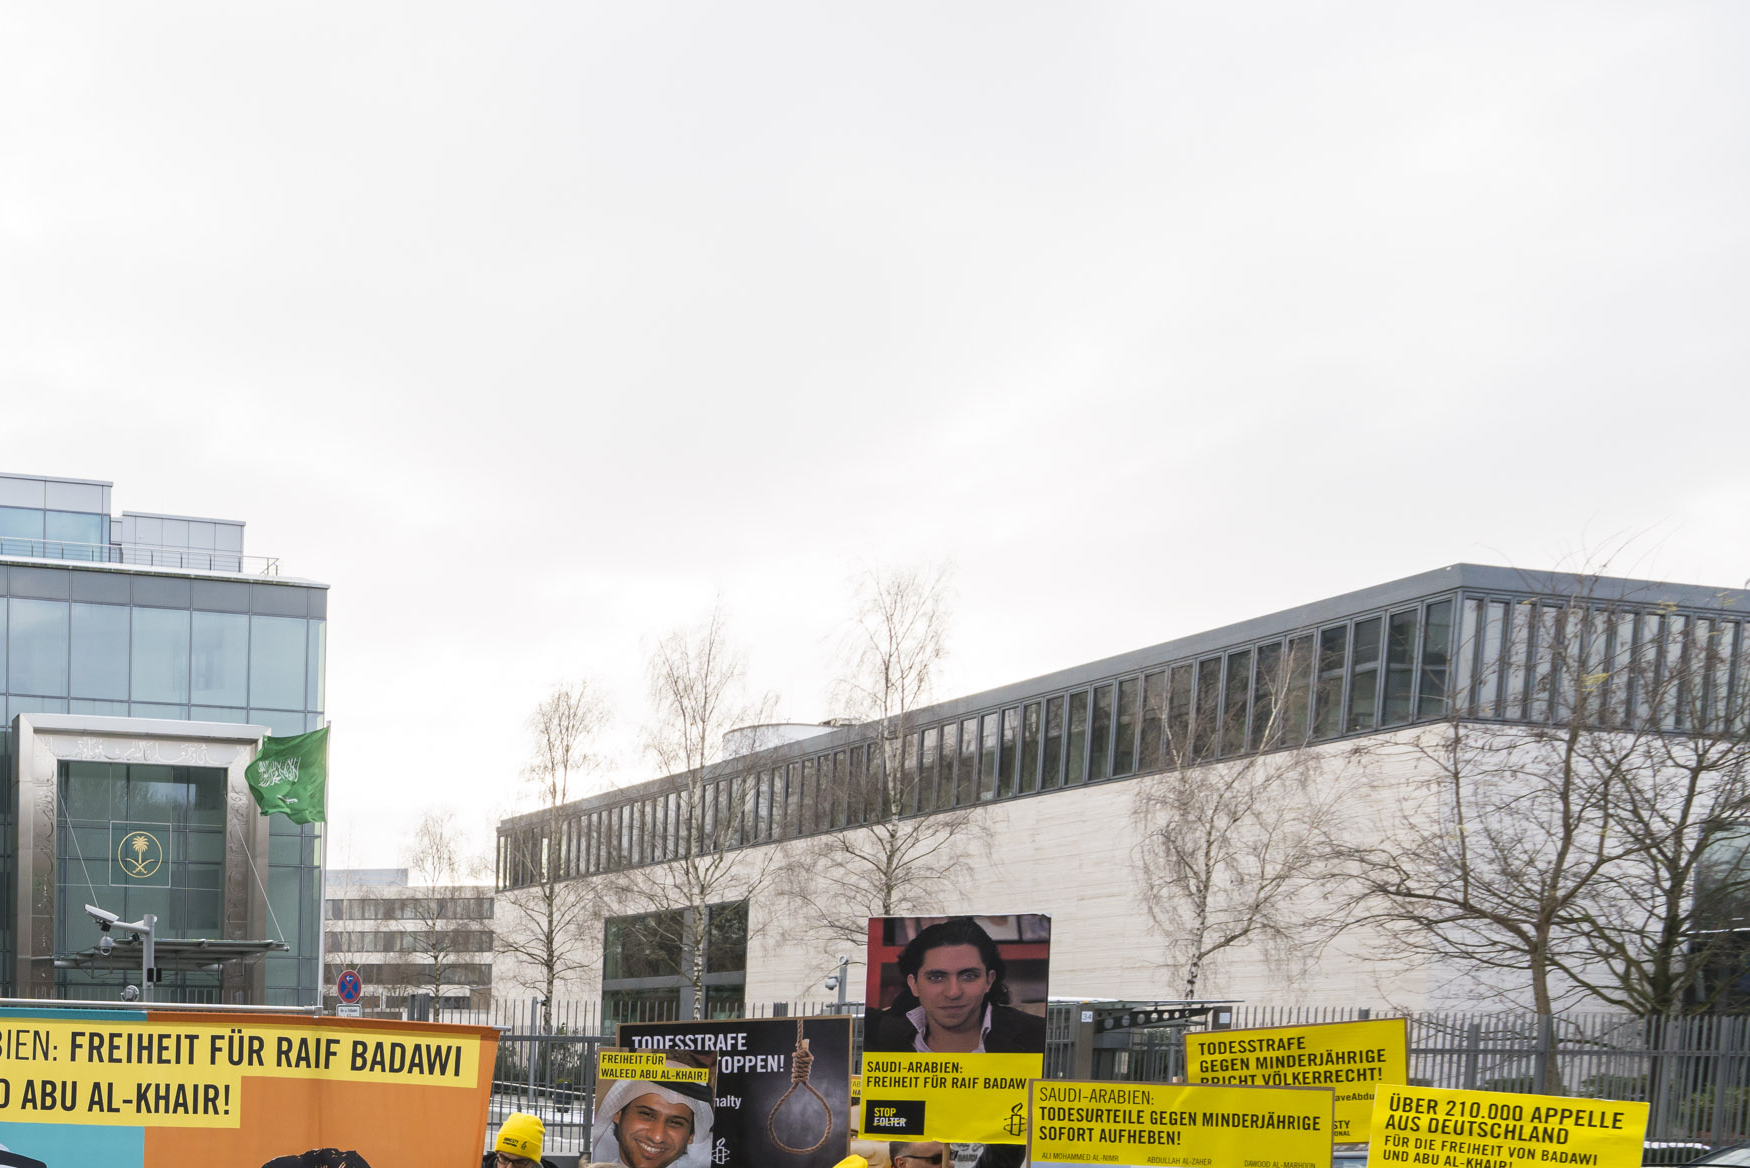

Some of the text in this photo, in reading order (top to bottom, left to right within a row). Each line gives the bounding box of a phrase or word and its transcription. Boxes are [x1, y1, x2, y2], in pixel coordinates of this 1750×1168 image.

[1082, 1013, 1091, 1021] 34
[632, 1033, 747, 1051] TODESSTRAFE
[1199, 1036, 1305, 1055] TODESSTRAFE
[70, 1031, 199, 1065] FREIHEIT
[210, 1029, 265, 1066] FÜR
[276, 1036, 338, 1069] RAIF
[350, 1040, 461, 1076] BADAWI
[1200, 1049, 1386, 1073] GEGEN MINDERJÄHRIGE
[867, 1061, 963, 1073] SAUDI-ARABIEN:
[1262, 1067, 1382, 1085] VÖLKERRECHT!
[21, 1080, 77, 1111] ABU
[88, 1082, 230, 1115] AL-KHAIR!
[1040, 1087, 1154, 1106] SAUDI-ARABIEN:
[874, 1108, 896, 1116] STOP
[1040, 1107, 1145, 1125] TODESURTEILE
[1150, 1110, 1197, 1126] GEGEN
[1202, 1111, 1320, 1131] MINDERJÄHRIGE
[1390, 1093, 1625, 1130] ÜBER 210.000 APPELLE
[1040, 1126, 1181, 1145] SOFORT AUFHEBEN!
[1385, 1114, 1569, 1145] AUS DEUTSCHLAND
[1053, 1153, 1090, 1161] MOHAMMED
[1093, 1154, 1119, 1162] AL-NIMR
[1147, 1156, 1180, 1164] ABDULLAH
[1245, 1160, 1316, 1168] DAWOOD AL-MARHOON
